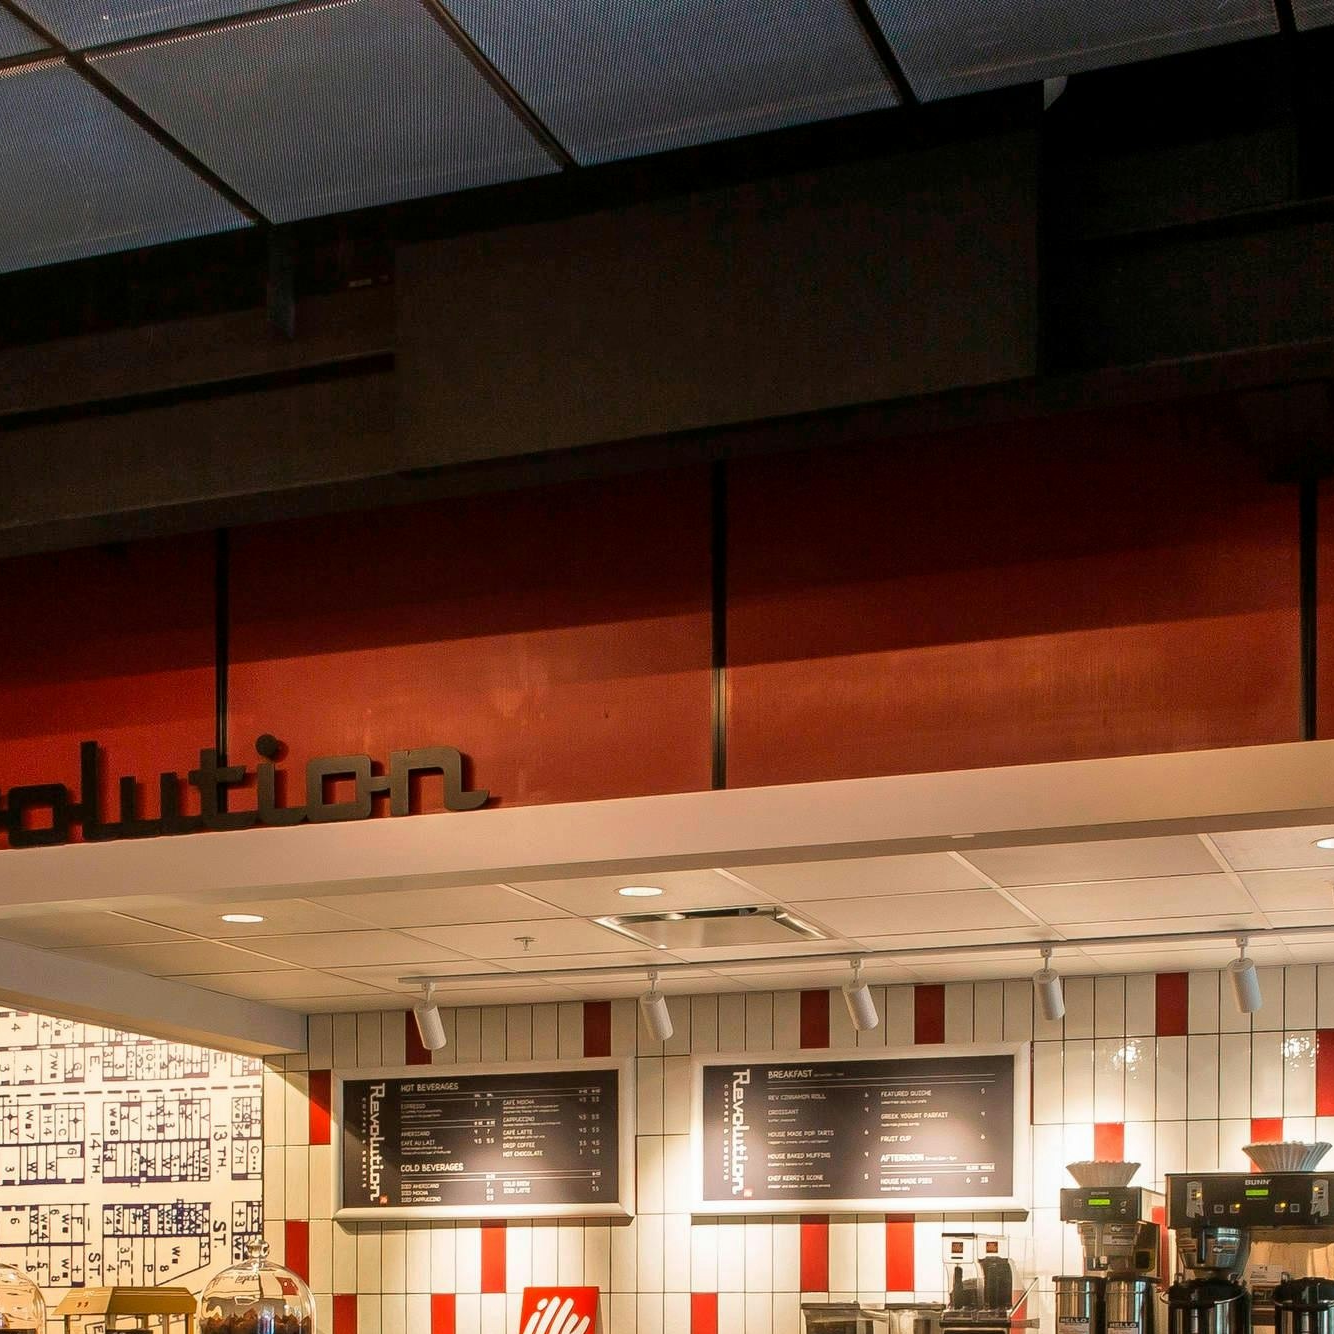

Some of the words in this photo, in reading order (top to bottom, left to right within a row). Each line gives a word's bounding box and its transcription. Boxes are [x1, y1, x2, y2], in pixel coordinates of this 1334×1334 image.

[768, 1070, 812, 1079] BREAKFAST
[401, 1084, 414, 1092] HOT
[417, 1083, 459, 1092] BEVERAGES
[732, 1069, 750, 1195] Revolution
[370, 1083, 385, 1201] Revolution
[881, 1154, 924, 1162] AFTERNOON
[400, 1164, 420, 1172] COLD
[422, 1163, 464, 1172] BEVERAGES
[213, 1220, 227, 1248] ST.
[88, 1252, 101, 1280] ST.
